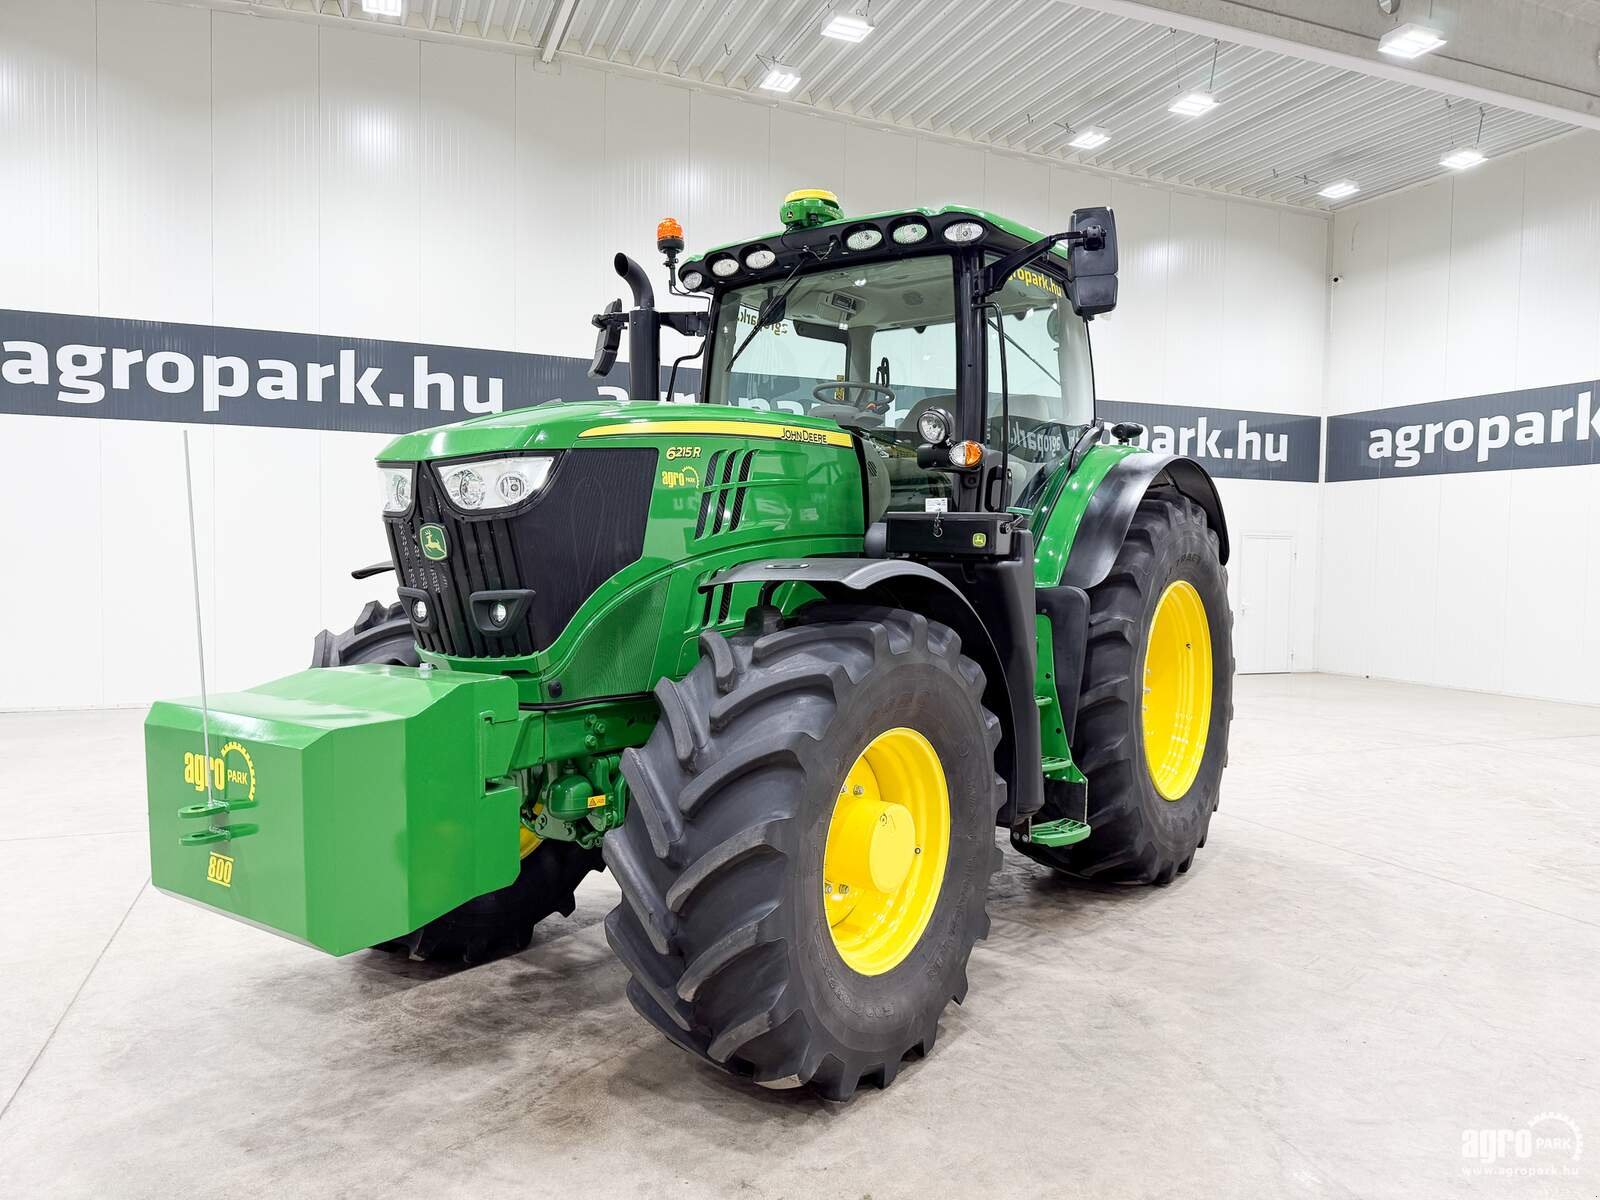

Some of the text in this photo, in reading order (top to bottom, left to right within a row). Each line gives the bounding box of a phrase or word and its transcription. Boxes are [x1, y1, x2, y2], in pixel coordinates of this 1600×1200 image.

[1, 340, 503, 413] agropark.hu
[781, 427, 828, 444] JOHN DEERE
[661, 471, 685, 488] agro
[184, 752, 248, 791] agro PARK
[208, 856, 232, 884] 800
